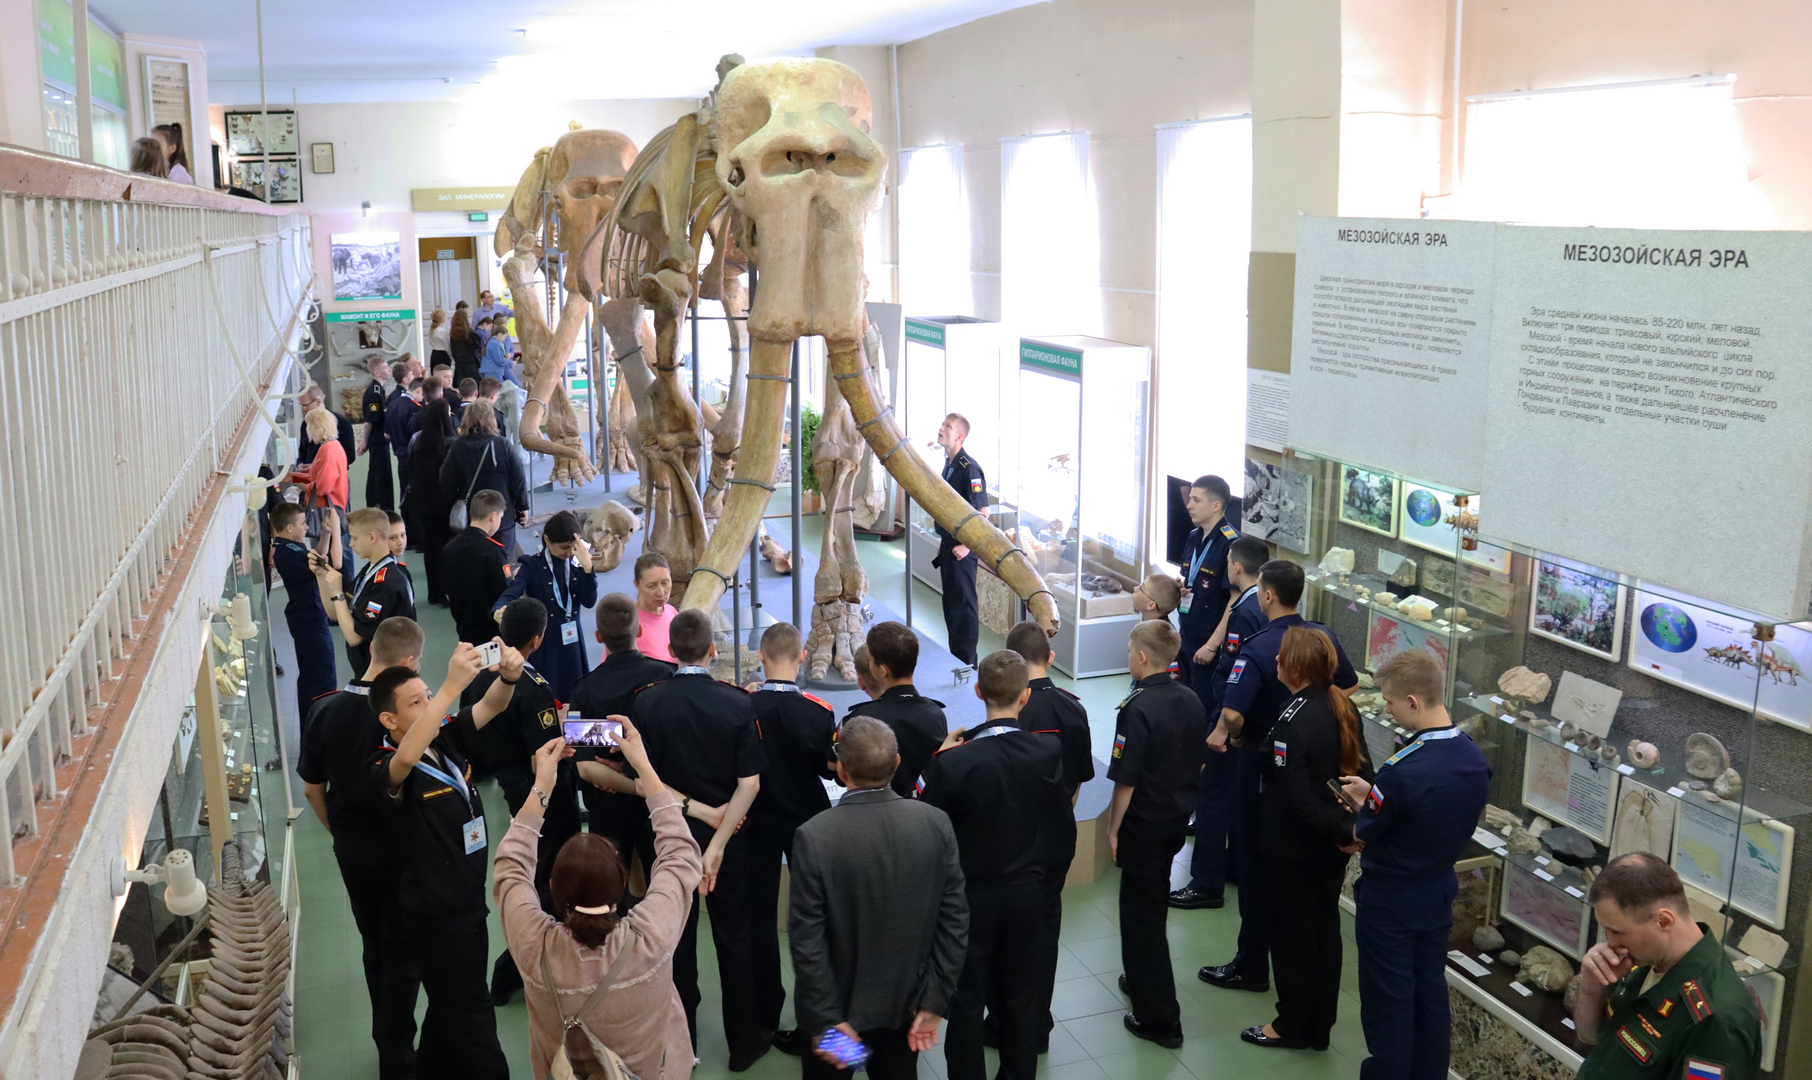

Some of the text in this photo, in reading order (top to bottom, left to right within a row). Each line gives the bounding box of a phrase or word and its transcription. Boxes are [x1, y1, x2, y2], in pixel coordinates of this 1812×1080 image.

[1338, 229, 1448, 246] МЕЗОЗОЙСКАЯ ЭРА
[1563, 244, 1749, 268] МЕЗОЗОЙСКАЯ ЭРА
[1530, 307, 1546, 317] Эра
[1548, 310, 1581, 319] средней
[1582, 313, 1607, 321] жизни
[1609, 316, 1648, 325] началась
[1652, 318, 1684, 328] 85-220
[906, 325, 942, 340] ГИППАРИОНОВАЯ ФАУНА
[1522, 319, 1753, 348] Включает три периода: триасовый, юрский, меловой.
[1529, 331, 1562, 341] Мезозой
[1568, 337, 1593, 345] время
[1596, 340, 1625, 348] начала
[1627, 343, 1657, 352] нового
[1659, 346, 1718, 358] альпийского
[1723, 353, 1754, 362] цикла
[1022, 348, 1077, 368] ГИППАРИОНОВАЯ ФАУНА
[1521, 345, 1602, 360] складкообразования,
[1605, 354, 1640, 364] который
[1656, 360, 1709, 371] закончился
[1735, 369, 1753, 377] сих
[1755, 371, 1777, 380] пор.
[1519, 368, 1545, 376] горных
[1611, 380, 1661, 392] периферии
[1664, 386, 1696, 398] Тихого,
[1699, 391, 1779, 409] Атлантического
[1563, 362, 1610, 373] процессами
[1612, 368, 1645, 377] связано
[1647, 372, 1718, 387] возникновение
[1720, 381, 1763, 393] крупных
[1518, 390, 1553, 402] Гондваны
[1562, 397, 1600, 409] Лавразии
[1615, 406, 1662, 419] отдельные
[1664, 414, 1700, 425] участки
[1702, 420, 1728, 429] суши
[1522, 402, 1555, 415] будущие
[1559, 411, 1607, 425] континенты.
[1525, 381, 1568, 393] Индийского
[1571, 389, 1603, 399] океанов,
[1616, 395, 1640, 403] также
[1641, 398, 1699, 412] дальнейшее
[1701, 407, 1767, 422] расчленение
